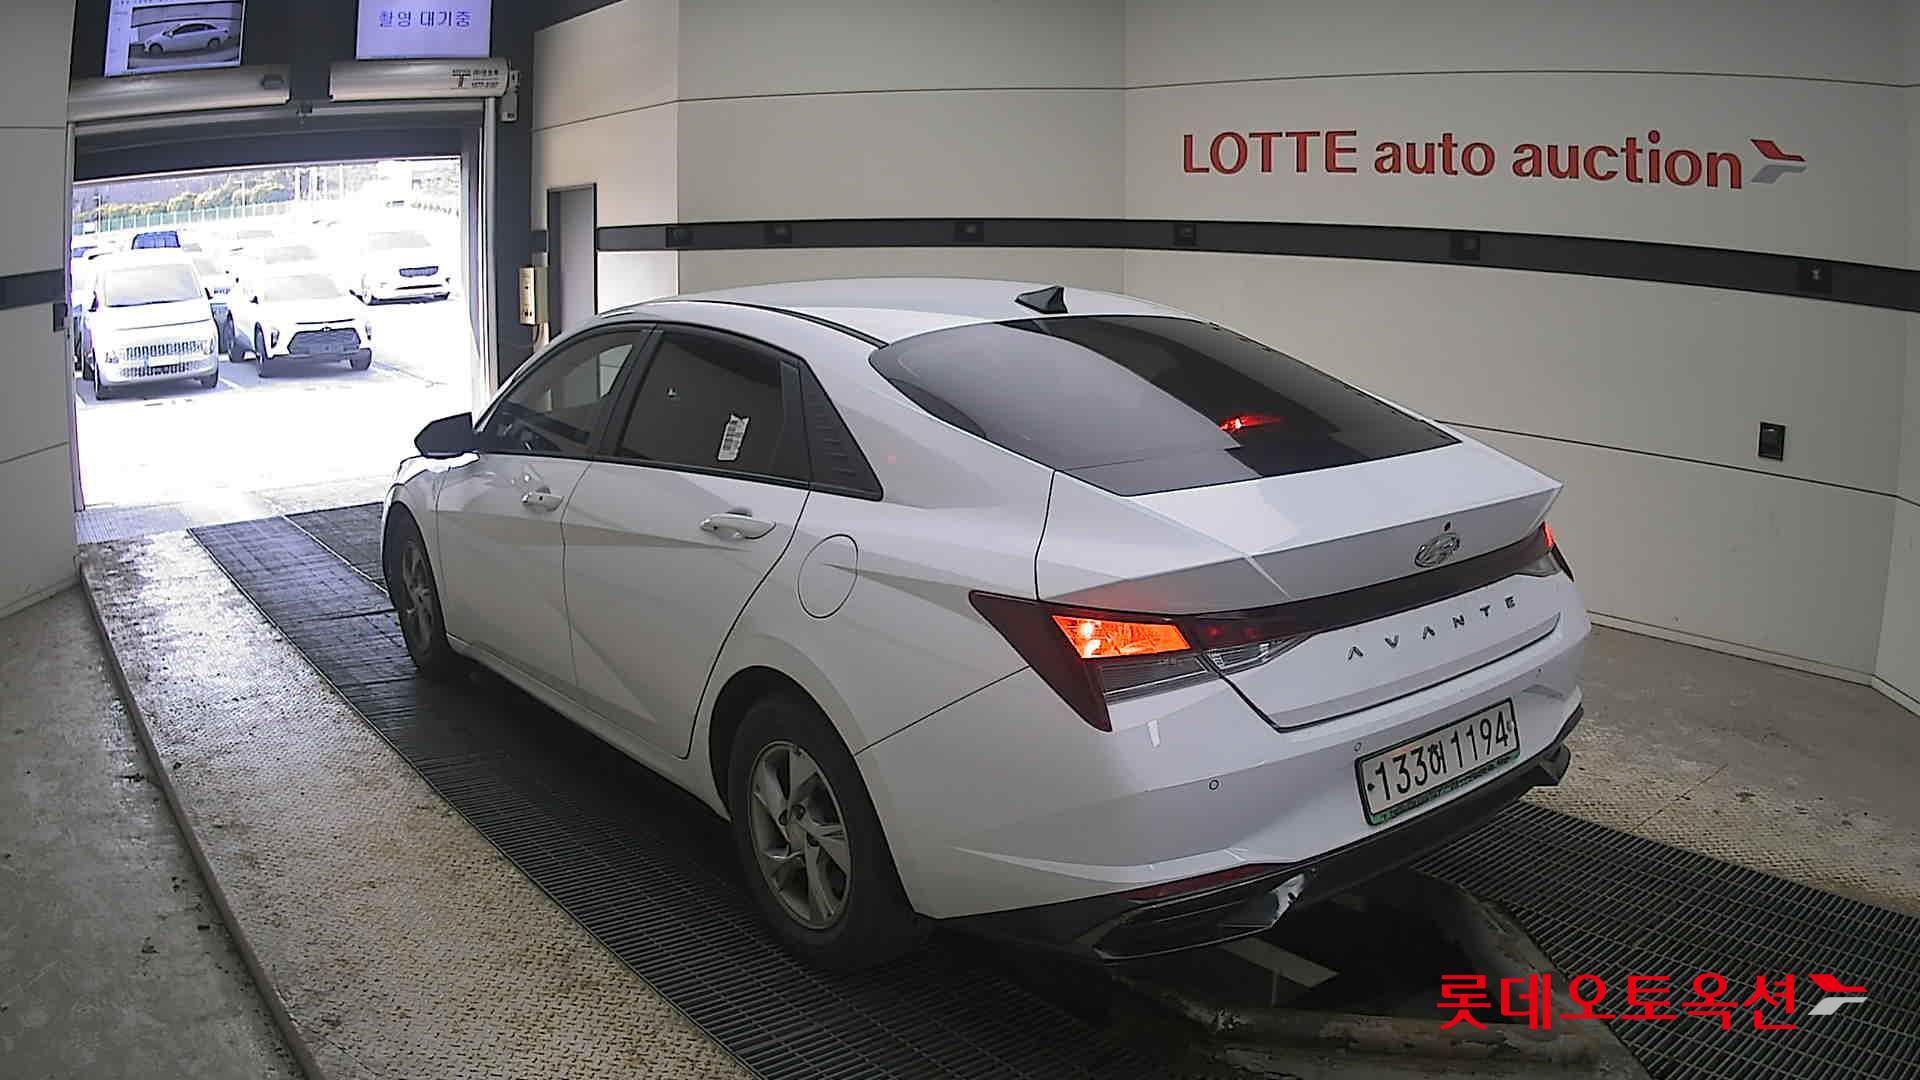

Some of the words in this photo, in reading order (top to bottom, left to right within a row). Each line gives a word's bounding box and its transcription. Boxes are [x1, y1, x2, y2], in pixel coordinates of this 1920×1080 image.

[379, 10, 412, 28] 촬영
[420, 10, 472, 28] 대기중
[1184, 131, 1358, 175] LOTTE
[1375, 132, 1496, 177] auto
[1512, 130, 1744, 189] auction
[1346, 595, 1517, 661] AVANTE
